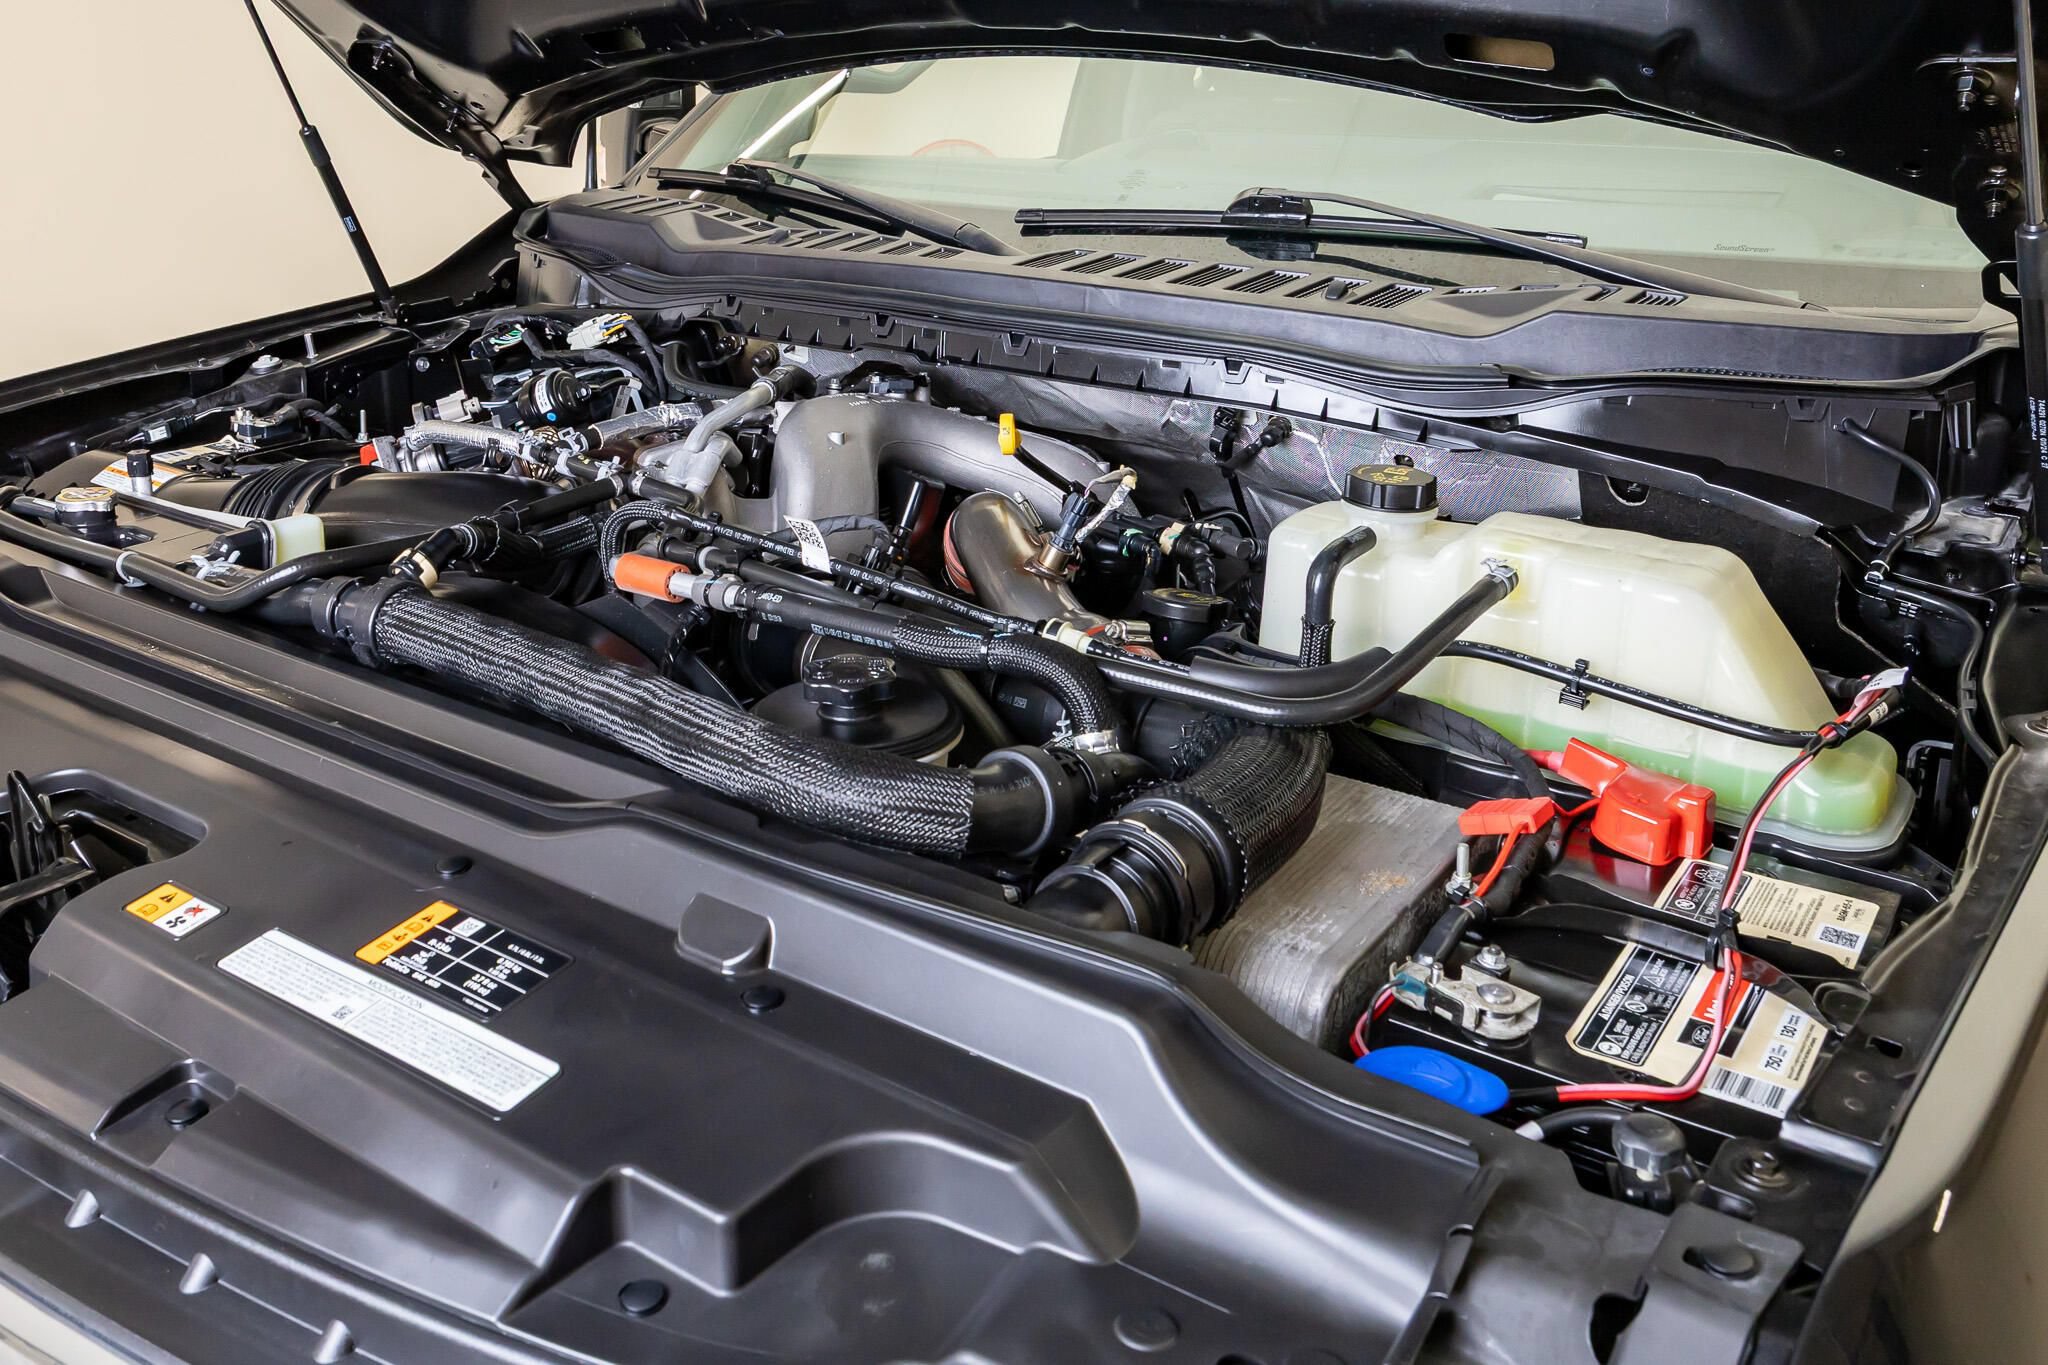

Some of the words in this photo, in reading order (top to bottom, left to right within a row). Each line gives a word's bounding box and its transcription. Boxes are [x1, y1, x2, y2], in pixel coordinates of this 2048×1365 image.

[1714, 243, 1769, 253] SoundScreen
[1779, 1024, 1796, 1039] 130
[1764, 1055, 1783, 1071] 750
